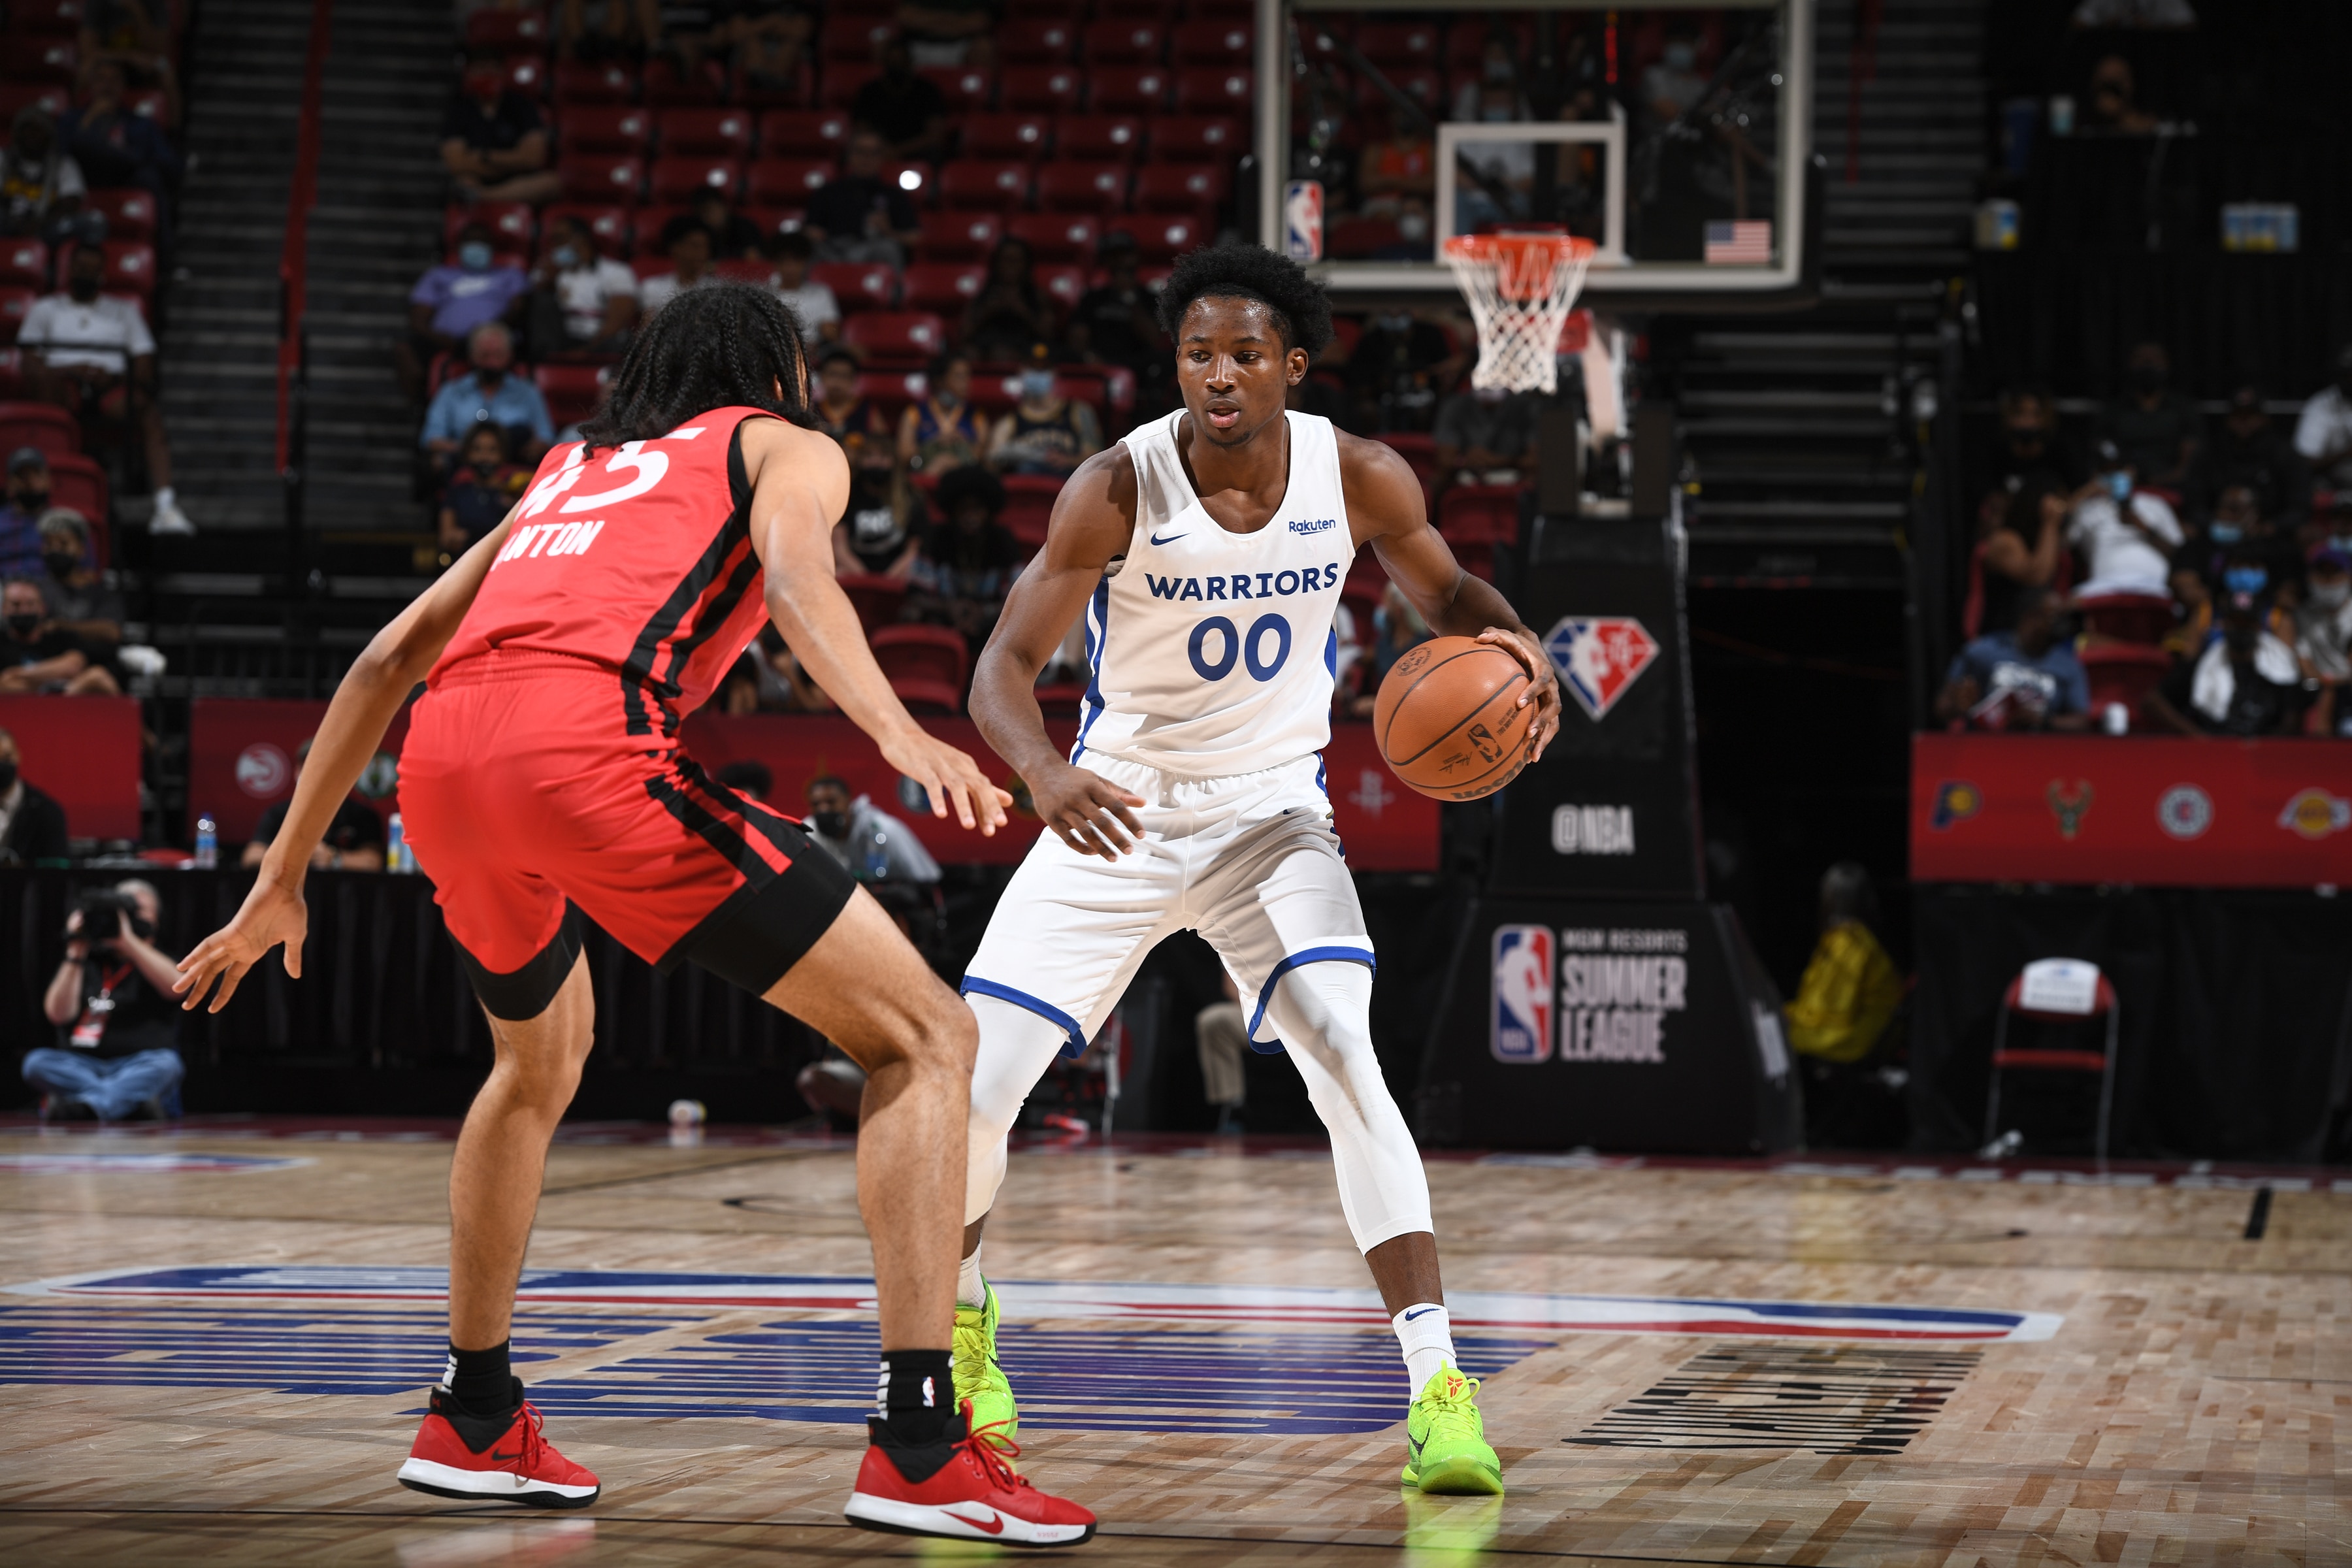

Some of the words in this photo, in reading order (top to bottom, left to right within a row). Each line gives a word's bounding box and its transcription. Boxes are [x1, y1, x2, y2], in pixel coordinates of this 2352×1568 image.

[1288, 519, 1336, 533] Rakuten
[1145, 563, 1339, 601] WARRIORS
[1187, 613, 1292, 682] 00
[1552, 803, 1635, 855] @NBA
[1608, 929, 1688, 952] RESORTS
[1562, 954, 1688, 1010] SUMMER
[1561, 1009, 1665, 1061] LEAGUE
[1565, 1377, 1957, 1456] RESORTS
